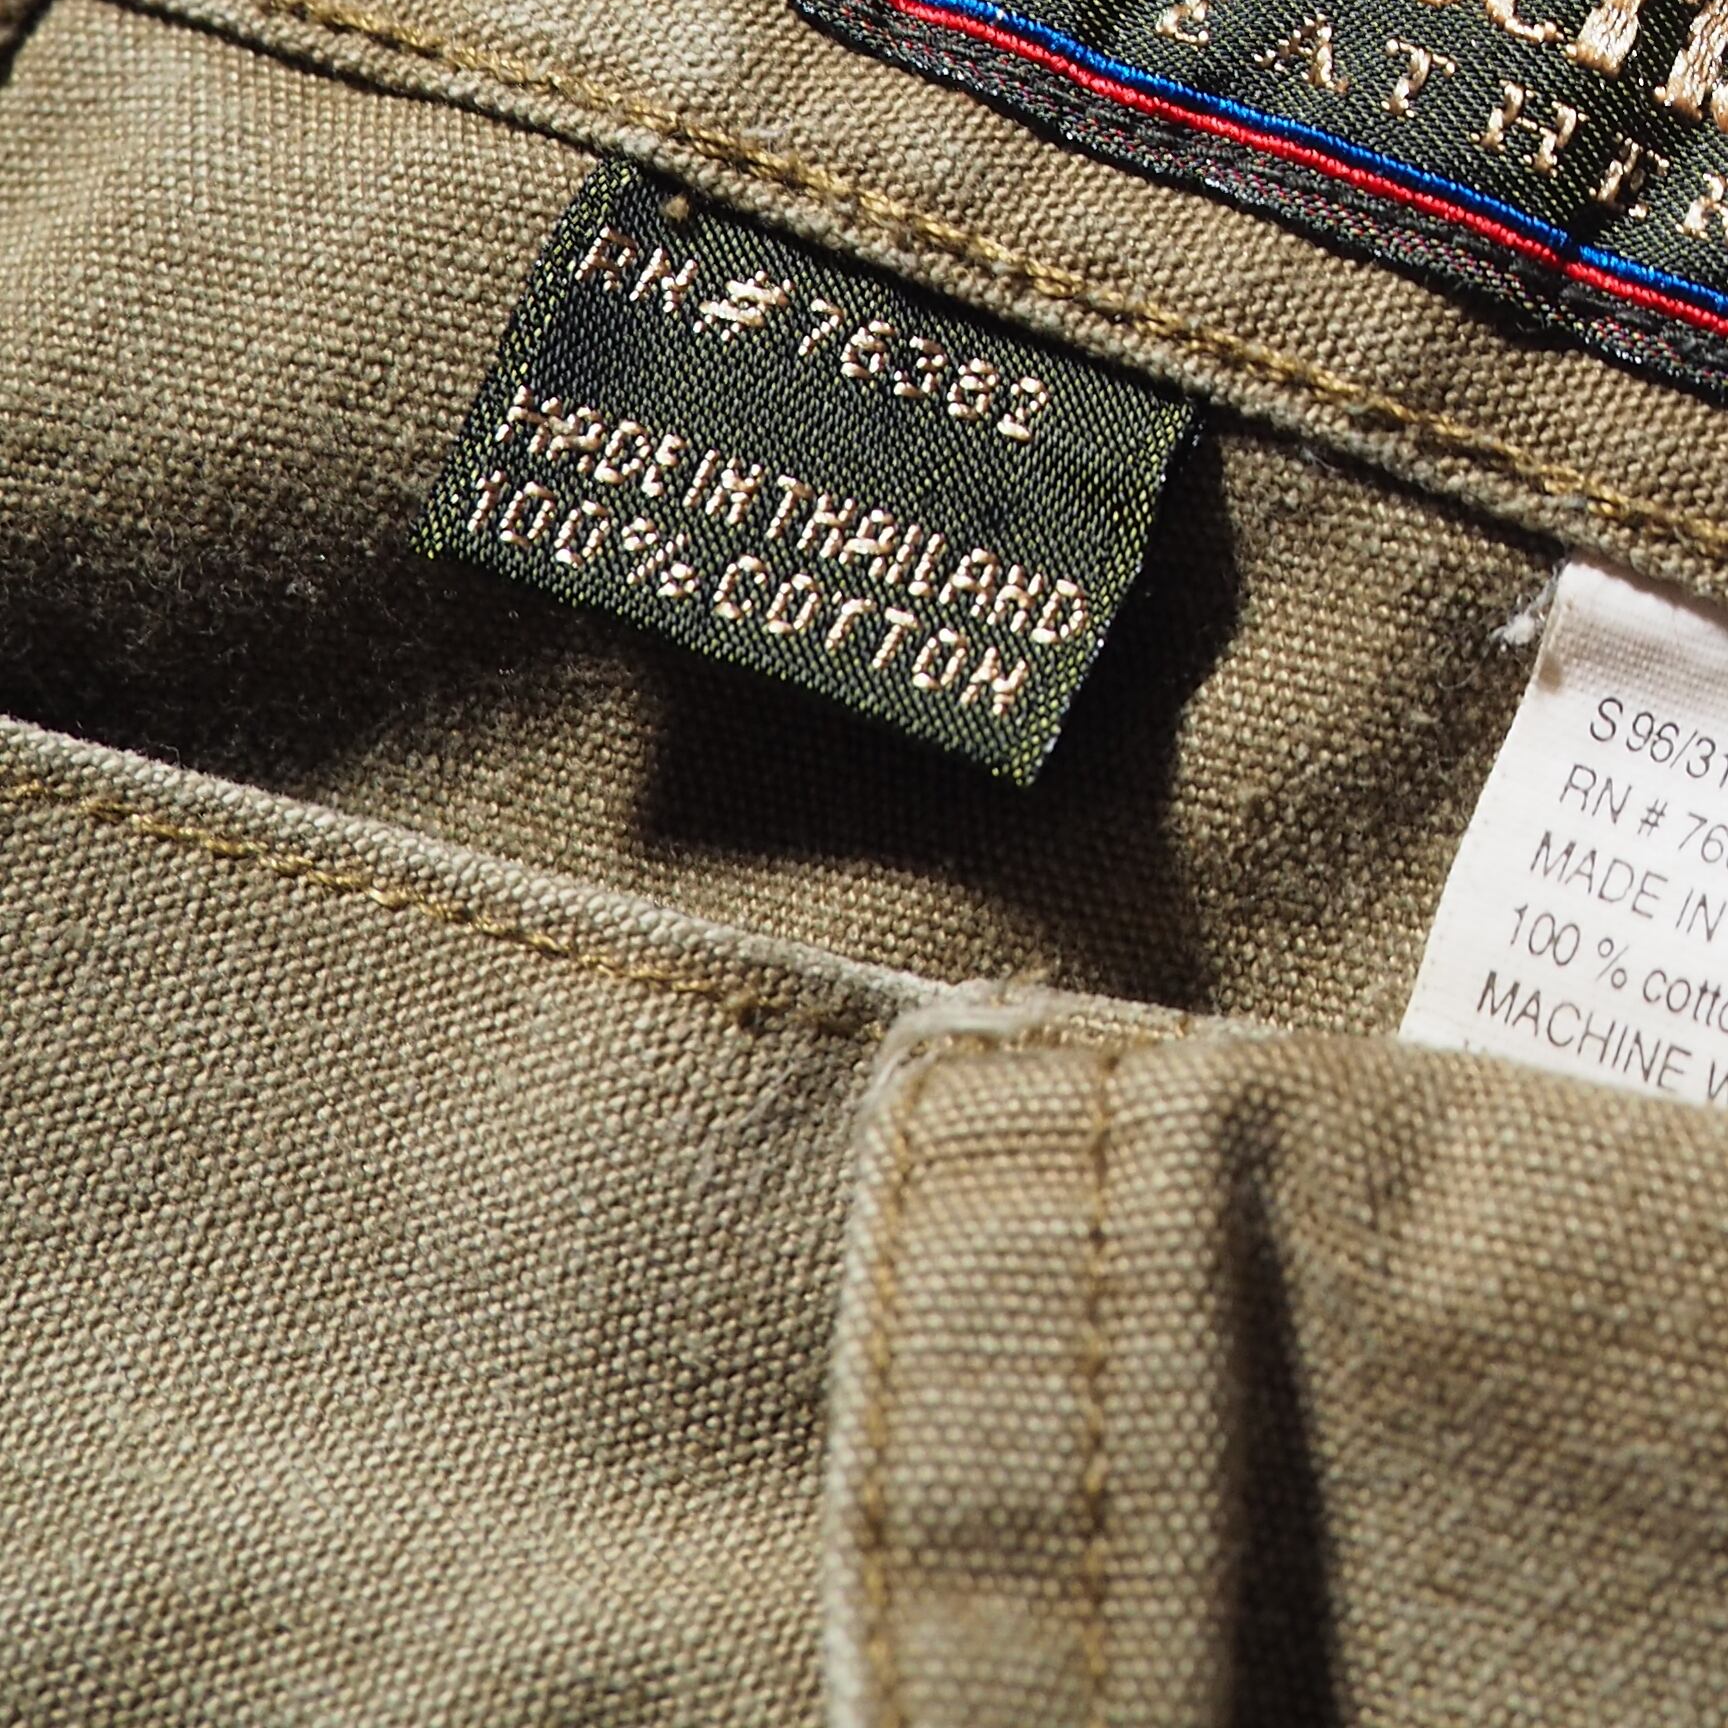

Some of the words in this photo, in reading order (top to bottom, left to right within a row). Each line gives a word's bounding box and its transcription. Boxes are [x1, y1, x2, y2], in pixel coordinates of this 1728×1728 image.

[576, 226, 698, 312] RN
[798, 298, 1050, 442] 76382
[495, 385, 685, 497] MADE
[683, 449, 765, 525] IN
[768, 474, 1089, 644] THAILAND
[467, 470, 701, 597] 100%
[714, 554, 1029, 716] COTTON
[1589, 697, 1625, 741] S
[1559, 764, 1631, 823] RN
[1638, 800, 1668, 835] #
[1530, 831, 1667, 919] MADE
[1676, 889, 1728, 943] IN
[1509, 903, 1580, 966] 100
[1597, 938, 1627, 990] %
[1475, 971, 1692, 1092] MACHINE
